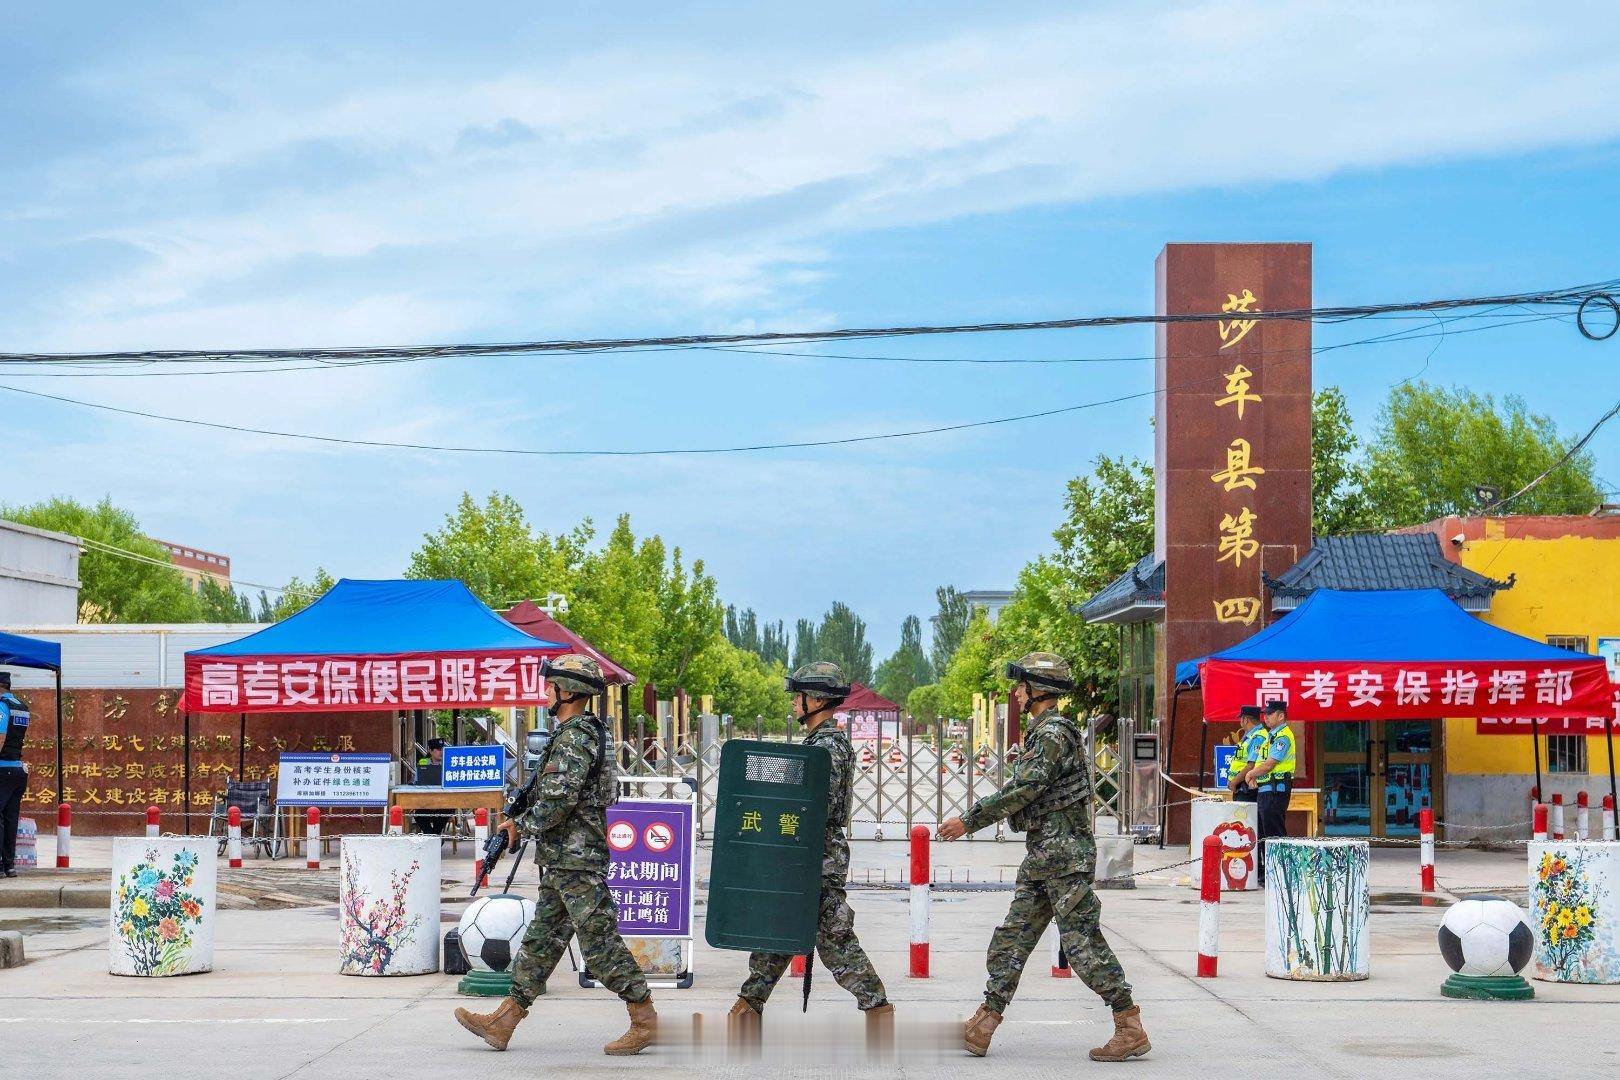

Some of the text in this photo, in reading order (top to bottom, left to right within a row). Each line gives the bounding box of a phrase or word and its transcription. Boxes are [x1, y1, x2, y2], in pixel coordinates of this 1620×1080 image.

[1211, 288, 1265, 627] 莎车县第四
[201, 655, 549, 706] 高考安保便民服务站
[1253, 668, 1574, 708] 高考安保指挥部
[450, 754, 497, 767] 莎车县公安局
[293, 765, 372, 775] 高考学生身份核实
[445, 769, 501, 781] 临时身份证办理点
[292, 777, 372, 787] 补办证件绿色通道
[742, 811, 800, 836] 武警
[617, 907, 670, 923] 止鸣笛
